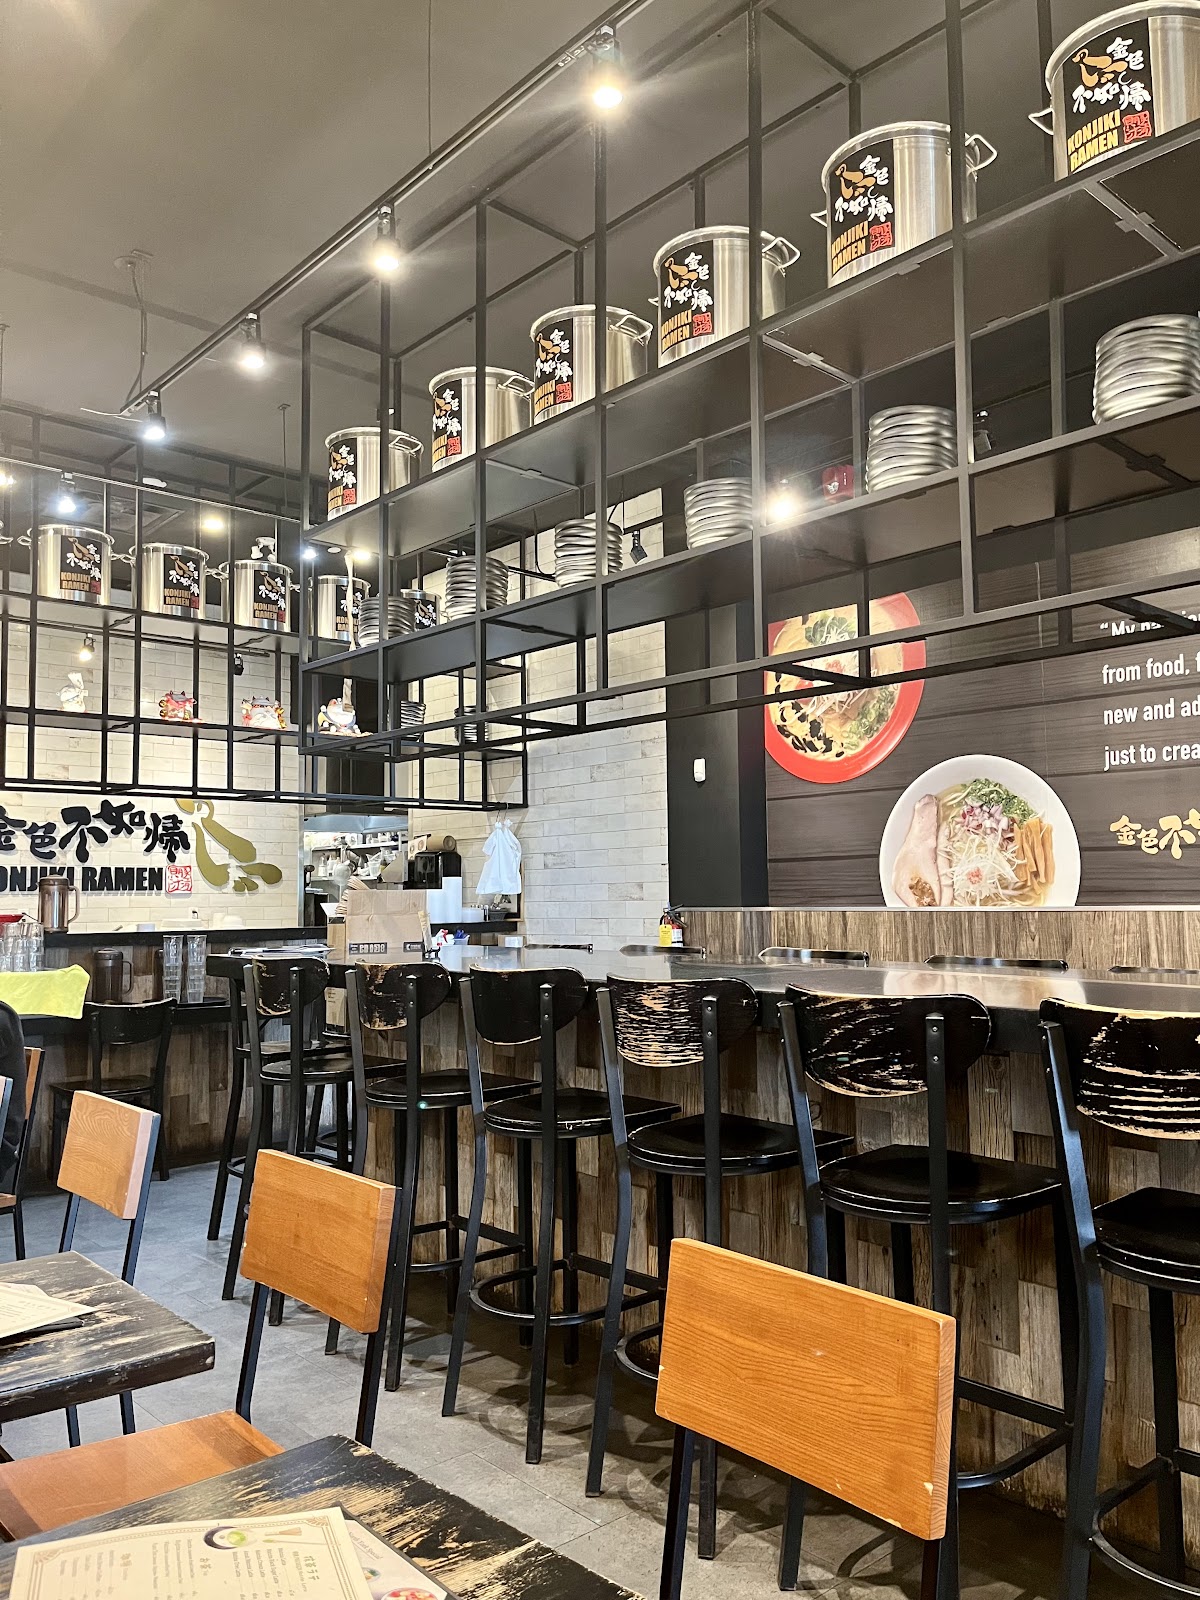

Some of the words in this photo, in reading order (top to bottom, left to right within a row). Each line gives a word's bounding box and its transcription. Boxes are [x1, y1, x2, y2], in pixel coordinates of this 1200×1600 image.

[1067, 108, 1121, 155] KONJIKI
[1070, 129, 1119, 172] RAMEN
[831, 220, 868, 260] KONJIKI
[832, 239, 866, 277] RAMEN
[61, 572, 91, 583] KONJIKI
[63, 581, 90, 591] RAMEN
[165, 588, 191, 598] KONJIKI
[166, 597, 189, 607] RAMEN
[1102, 664, 1141, 685] from
[1146, 653, 1190, 679] food,
[1103, 706, 1138, 725] new
[1143, 698, 1175, 721] and
[1104, 746, 1136, 771] just
[1140, 744, 1157, 763] to
[82, 866, 163, 892] RAMEN
